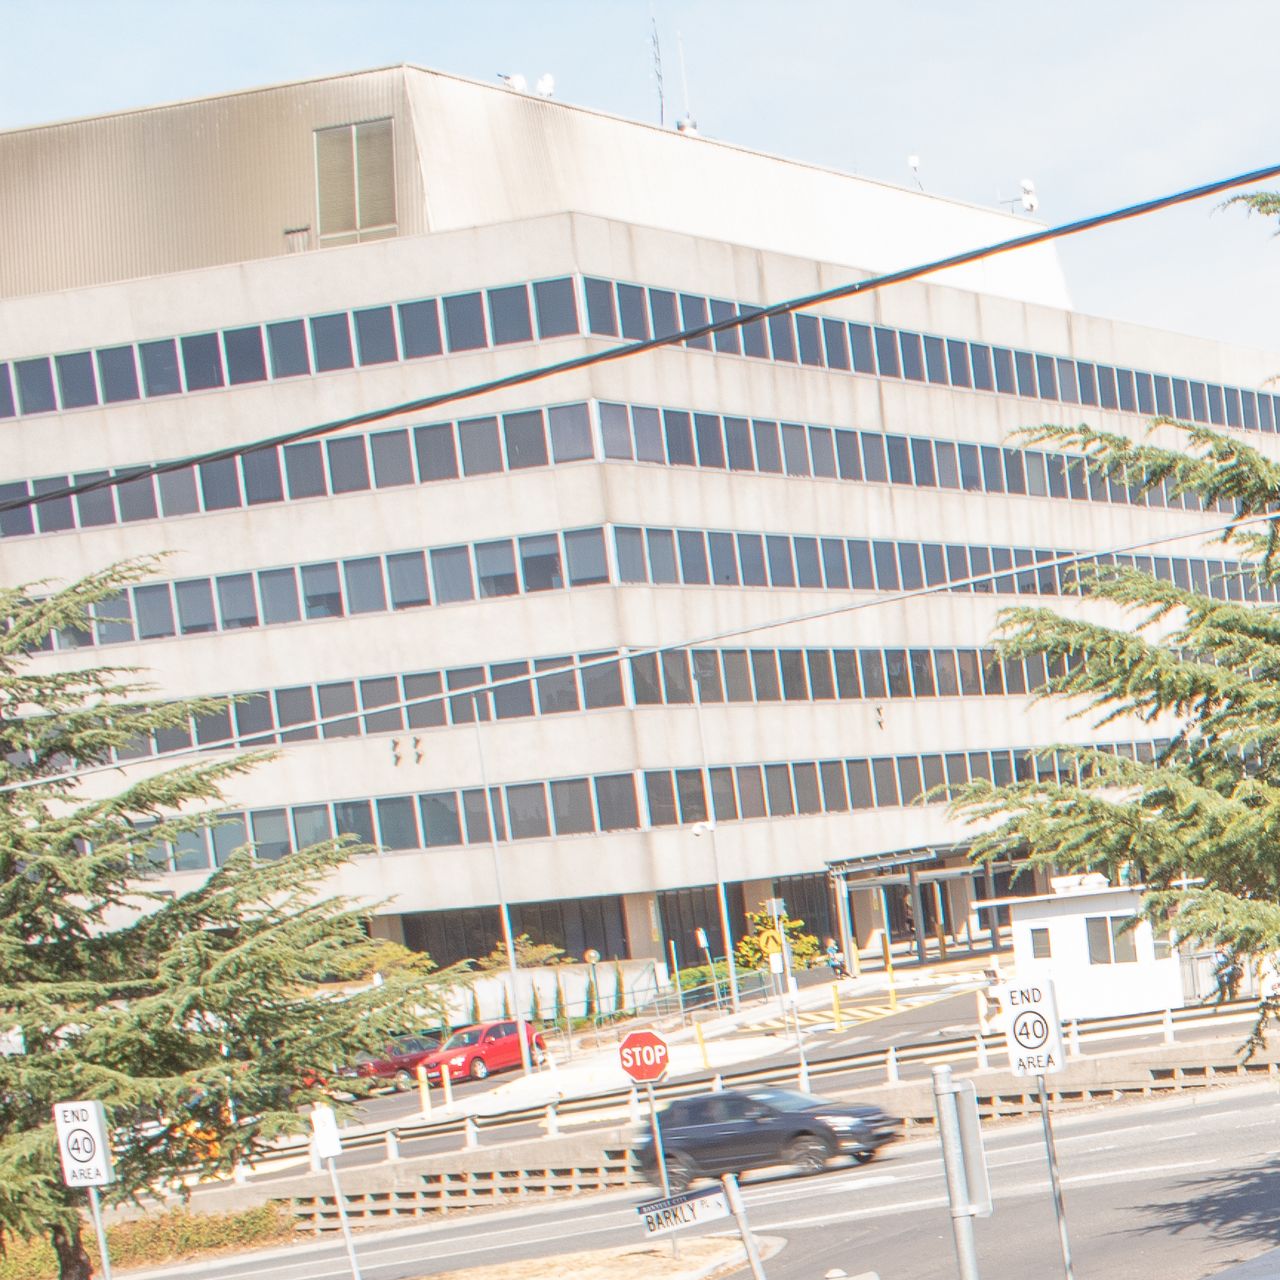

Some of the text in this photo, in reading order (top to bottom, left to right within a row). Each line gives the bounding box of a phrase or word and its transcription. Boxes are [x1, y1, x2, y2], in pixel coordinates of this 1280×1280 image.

[1010, 987, 1042, 1006] END
[1018, 1019, 1045, 1039] 40
[622, 1044, 666, 1068] STOP
[1018, 1053, 1055, 1071] AREA
[62, 1108, 89, 1124] END
[71, 1137, 93, 1154] 40
[71, 1168, 102, 1180] AREA
[645, 1202, 697, 1232] BARKLY
